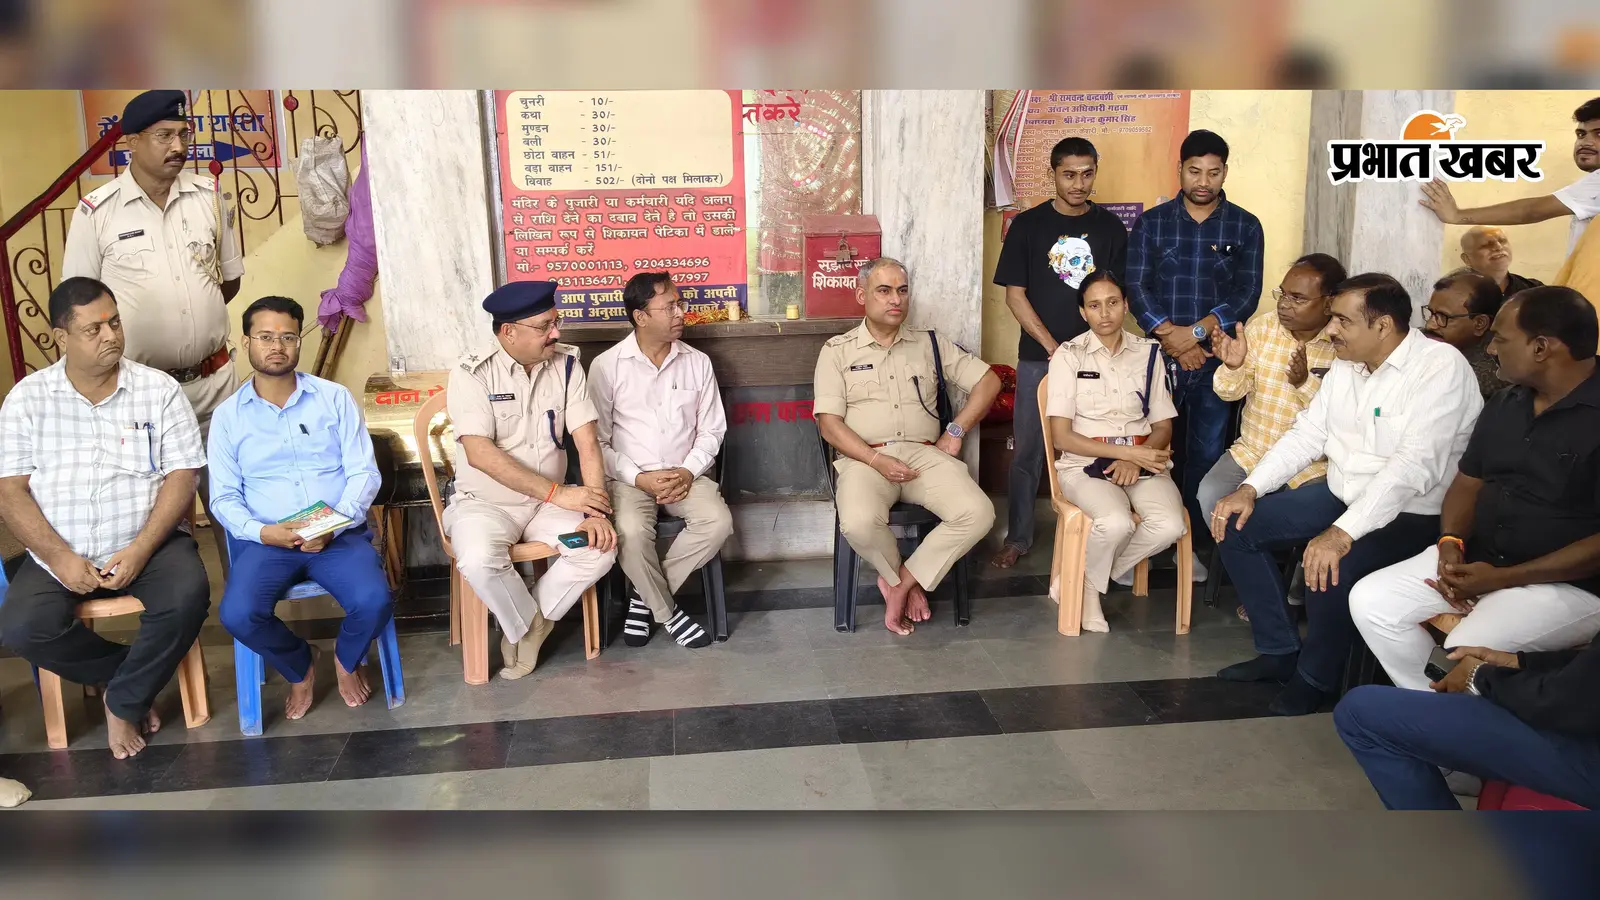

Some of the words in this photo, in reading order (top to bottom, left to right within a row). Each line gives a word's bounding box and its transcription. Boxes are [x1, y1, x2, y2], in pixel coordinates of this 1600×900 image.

[520, 95, 544, 109] चुनरी
[208, 114, 264, 131] रास्ता
[1098, 116, 1119, 124] कुमार
[1121, 114, 1136, 122] सिंह
[522, 125, 549, 135] मुण्डन
[523, 135, 541, 146] बली
[524, 148, 544, 159] छोटा
[551, 151, 575, 159] वाहन
[524, 164, 542, 174] बड़ा
[548, 164, 572, 173] वाहन
[525, 175, 552, 186] विवाह
[683, 172, 723, 184] मिलाकर)
[512, 196, 539, 208] मंदिर
[546, 196, 557, 208] के
[565, 196, 598, 210] पुजारी
[605, 198, 618, 208] या
[625, 193, 668, 207] कर्मचारी
[675, 194, 695, 206] यदि
[703, 195, 732, 205] अलग
[513, 213, 523, 224] से
[531, 212, 556, 224] राशि
[563, 212, 579, 223] देने
[587, 214, 602, 223] का
[608, 213, 636, 222] दबाव
[644, 210, 660, 222] देते
[667, 209, 676, 222] है
[683, 209, 696, 221] तो
[703, 208, 736, 220] उसकी
[514, 228, 552, 240] लिखित
[559, 230, 578, 239] रूप
[585, 227, 595, 239] से
[602, 226, 648, 239] शिकायत
[654, 225, 688, 237] पेटिका
[695, 224, 705, 236] में
[712, 223, 734, 235] डालें
[516, 247, 528, 256] या
[536, 243, 569, 255] सम्पर्क
[576, 242, 594, 255] करें
[547, 260, 628, 271] 9570001113,
[634, 258, 709, 268] 9204334696
[672, 273, 709, 282] 47997
[812, 272, 858, 290] शिकायत
[561, 293, 585, 304] आप
[682, 288, 699, 298] को
[704, 286, 737, 298] अपनी
[375, 390, 420, 405] दान
